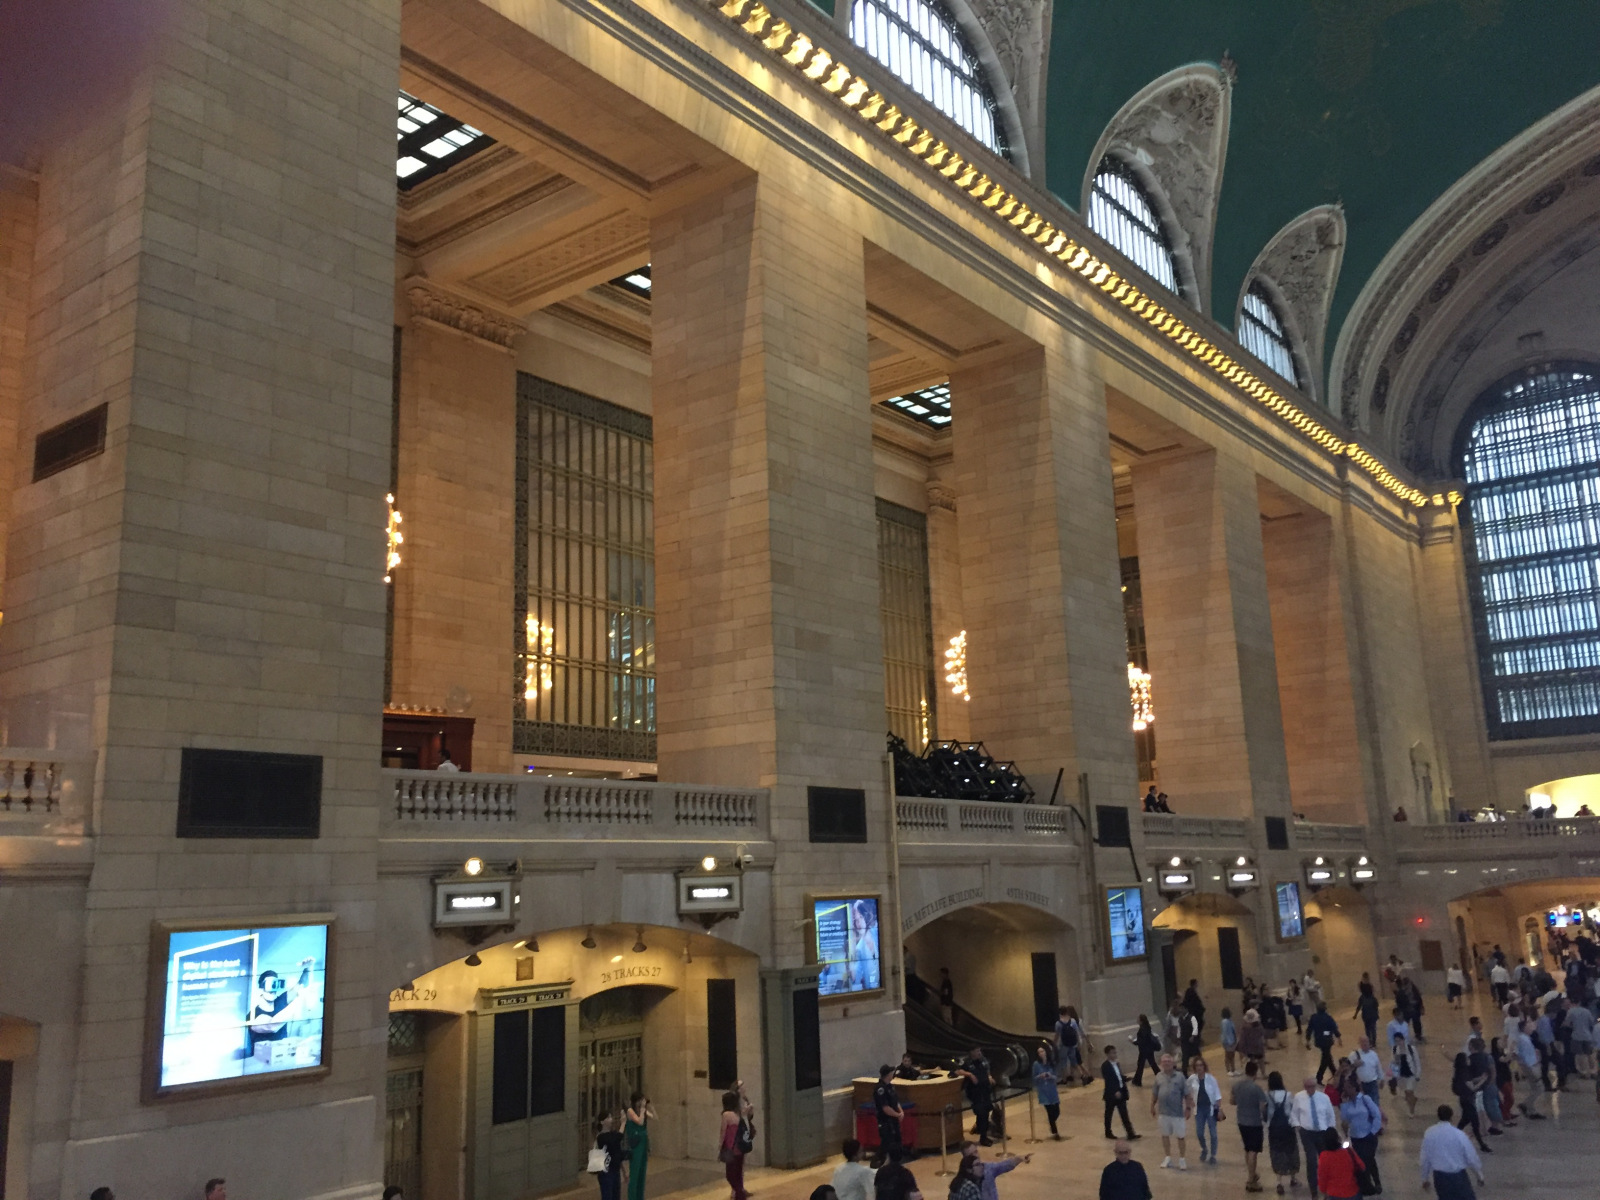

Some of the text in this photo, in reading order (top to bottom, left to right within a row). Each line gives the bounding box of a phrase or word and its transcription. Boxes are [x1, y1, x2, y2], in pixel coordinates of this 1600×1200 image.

[914, 897, 947, 923] METLIFE
[948, 887, 983, 906] BUILDING
[1025, 890, 1050, 906] STREET
[601, 966, 661, 983] 28 TRACKS 27
[423, 989, 437, 1001] 29
